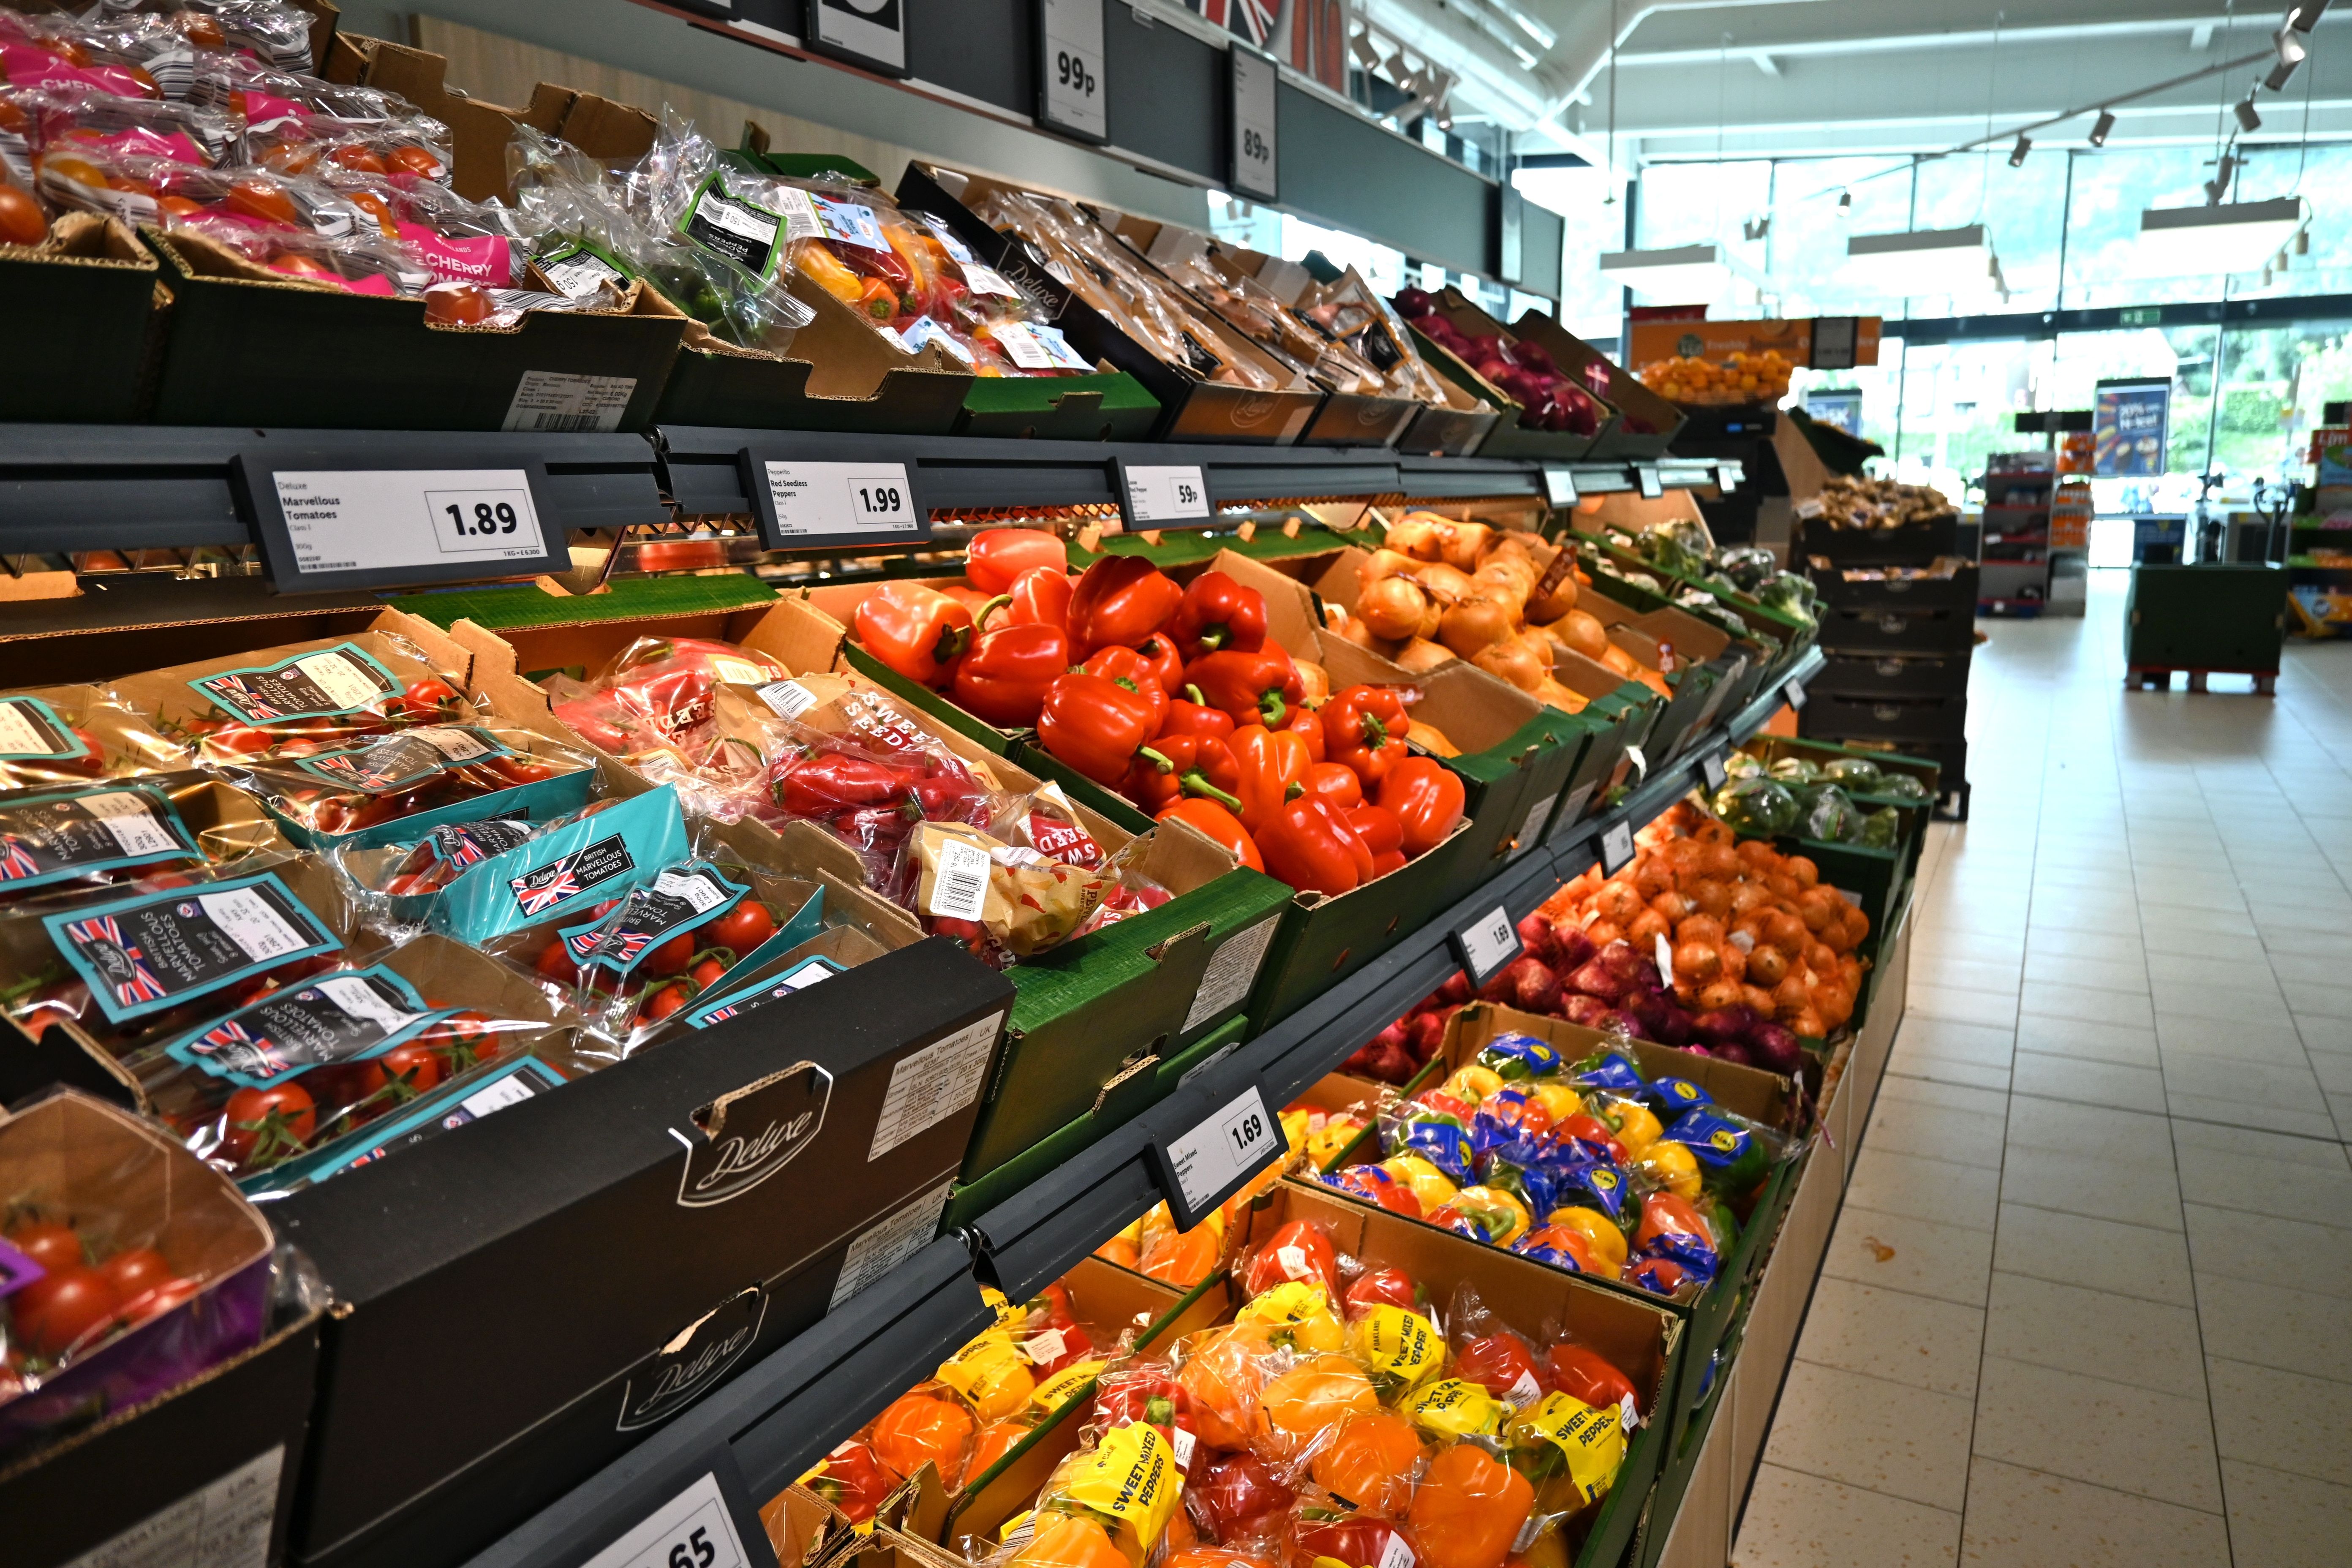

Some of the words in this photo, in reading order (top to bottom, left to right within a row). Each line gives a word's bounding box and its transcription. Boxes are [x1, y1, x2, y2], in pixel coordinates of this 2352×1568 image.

[1058, 51, 1094, 98] 99p
[1244, 128, 1269, 164] 89p
[729, 215, 741, 226] 150
[709, 232, 748, 252] PEPPERS
[427, 253, 493, 277] CHERRY
[1004, 260, 1059, 308] Deluxe
[278, 482, 307, 490] Deluxe
[1179, 485, 1198, 503] 59p
[283, 496, 340, 506] Marvellous
[860, 488, 900, 512] 1.99
[286, 510, 337, 520] Tomatoes
[446, 502, 517, 536] 1.89
[226, 688, 256, 707] Deluxe
[256, 675, 302, 710] MARVELLOUS
[257, 686, 281, 705] BRITISH
[270, 678, 308, 708] TOMATOES
[344, 691, 356, 703] 300g
[348, 683, 363, 699] L2901
[862, 691, 946, 748] SWEET
[456, 742, 471, 755] L2901
[844, 702, 950, 771] SEEDLESS
[452, 747, 464, 758] 300g
[576, 849, 622, 874] MARVELLOUS
[583, 847, 607, 861] BRITISH
[529, 868, 556, 887] Deluxe
[584, 859, 622, 881] TOMATOES
[694, 892, 707, 907] 300g
[695, 885, 712, 904] L2901
[706, 885, 720, 899] Supplier
[139, 909, 197, 982] MARVELLOUS
[139, 931, 168, 969] BRITISH
[159, 912, 207, 971] TOMATOES
[259, 1005, 334, 1062] MARVELLOUS
[265, 1021, 302, 1051] BRITISH
[280, 1002, 340, 1047] TOMATOES
[980, 1025, 992, 1037] UK
[895, 1052, 934, 1076] Marvellous
[936, 1034, 969, 1055] Tomatoes
[960, 1067, 967, 1075] 20
[974, 1056, 988, 1067] 300g
[1232, 1114, 1262, 1150] 1.69
[696, 1111, 813, 1190] Deluxe
[1173, 1157, 1185, 1169] Sweet
[1185, 1148, 1197, 1161] Mixed
[1177, 1164, 1193, 1178] Peppers
[932, 1191, 944, 1204] UK
[851, 1226, 888, 1253] Marvellous
[890, 1204, 921, 1228] Tomatoes
[635, 1326, 749, 1416] Deluxe
[1044, 1377, 1078, 1400] SWEET
[1556, 1411, 1588, 1440] SWEET
[1113, 1463, 1145, 1511] SWEET
[1138, 1431, 1156, 1464] MIXED
[1138, 1454, 1164, 1506] PEPPERS
